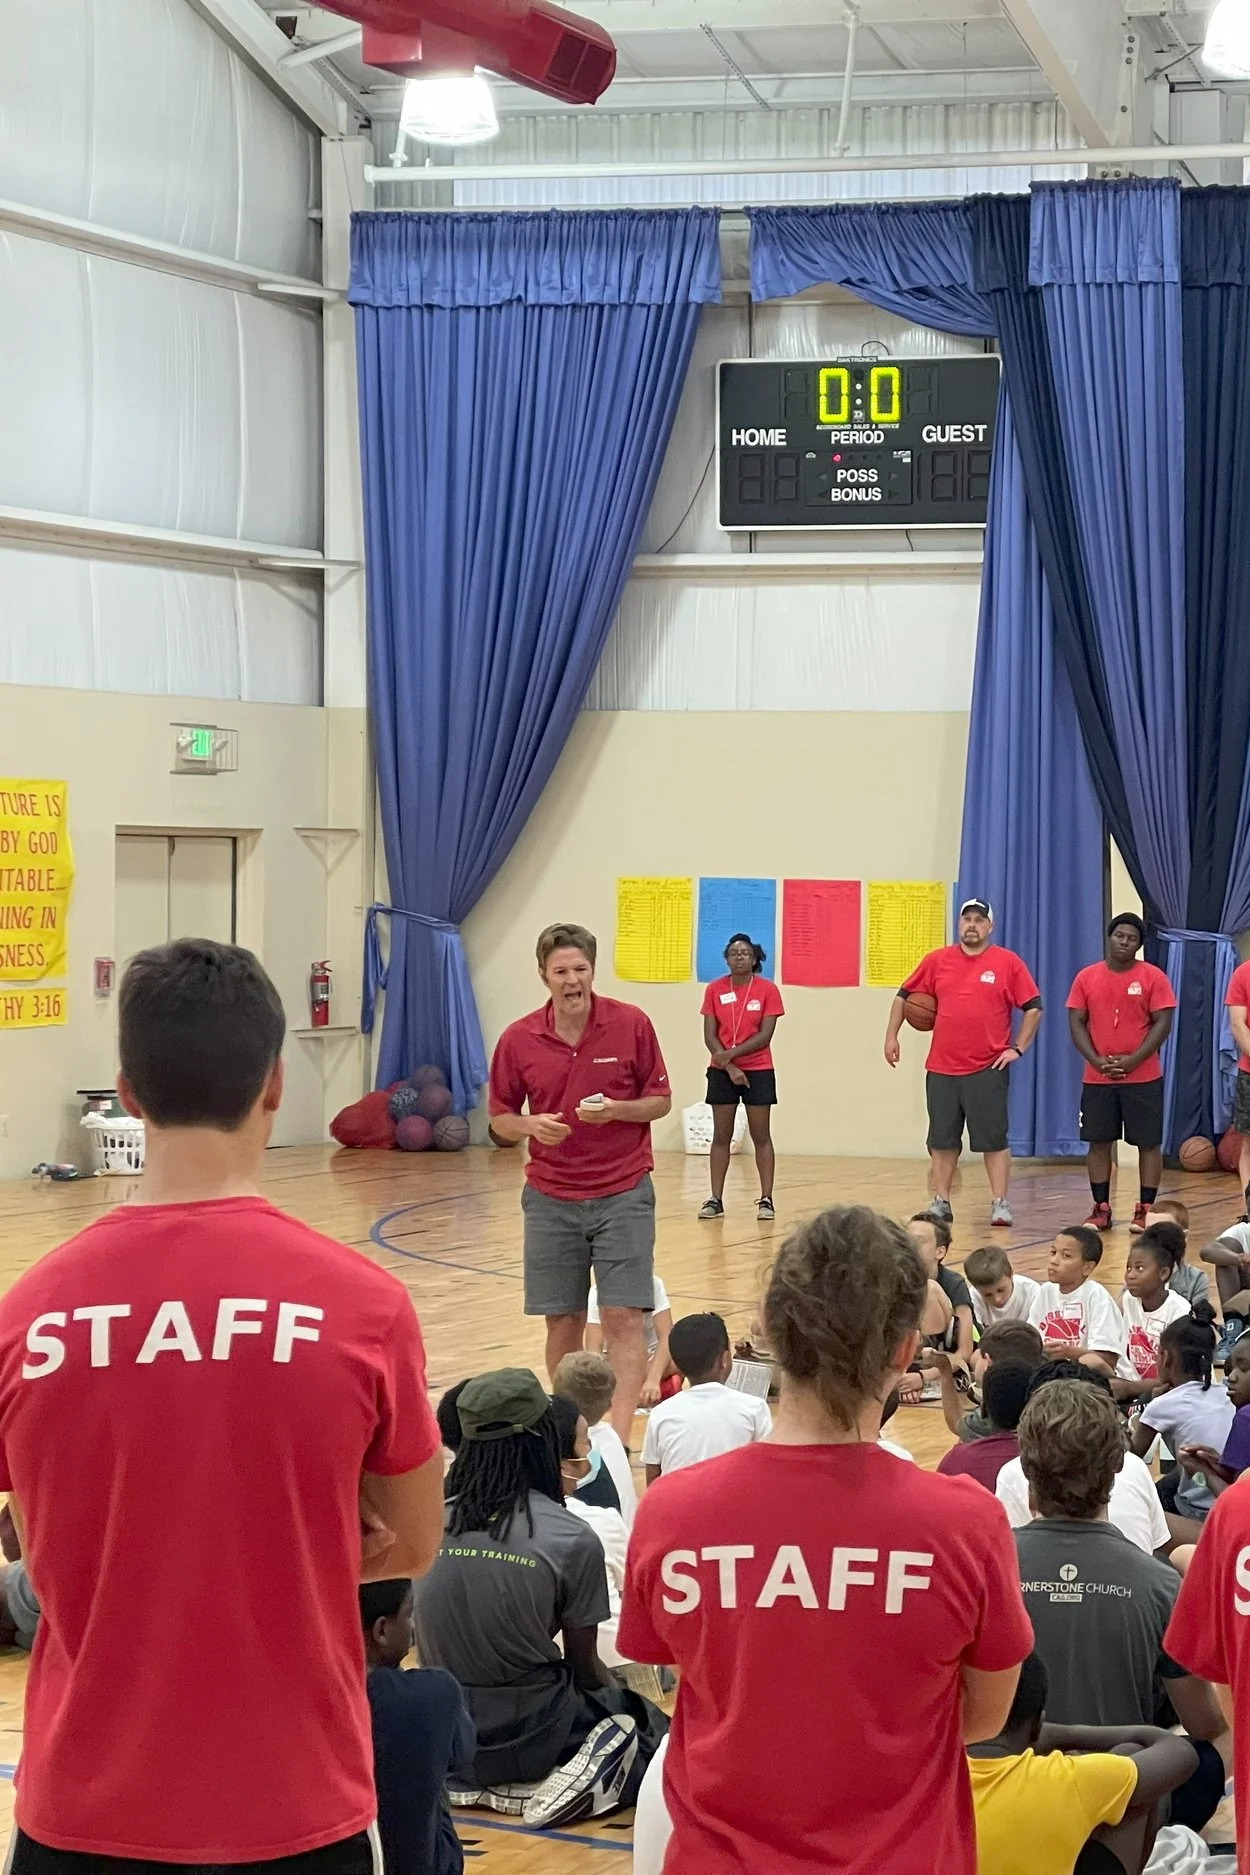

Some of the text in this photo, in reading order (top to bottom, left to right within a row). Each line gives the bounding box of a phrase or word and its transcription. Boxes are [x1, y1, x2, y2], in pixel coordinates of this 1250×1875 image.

[732, 428, 787, 446] HOME
[831, 430, 885, 444] PERIOD
[922, 424, 987, 443] GUEST
[836, 469, 878, 483] POSS
[831, 487, 882, 502] BONUS
[0, 792, 61, 817] TURE IS
[1, 830, 58, 855] BY GOD
[40, 906, 57, 929] IN
[0, 994, 61, 1020] HY 3:16
[21, 1298, 324, 1380] STAFF
[448, 1548, 477, 1557] YOUR
[482, 1550, 536, 1568] TRAINING
[661, 1545, 934, 1614] STAFF
[1086, 1583, 1132, 1598] CHURCH
